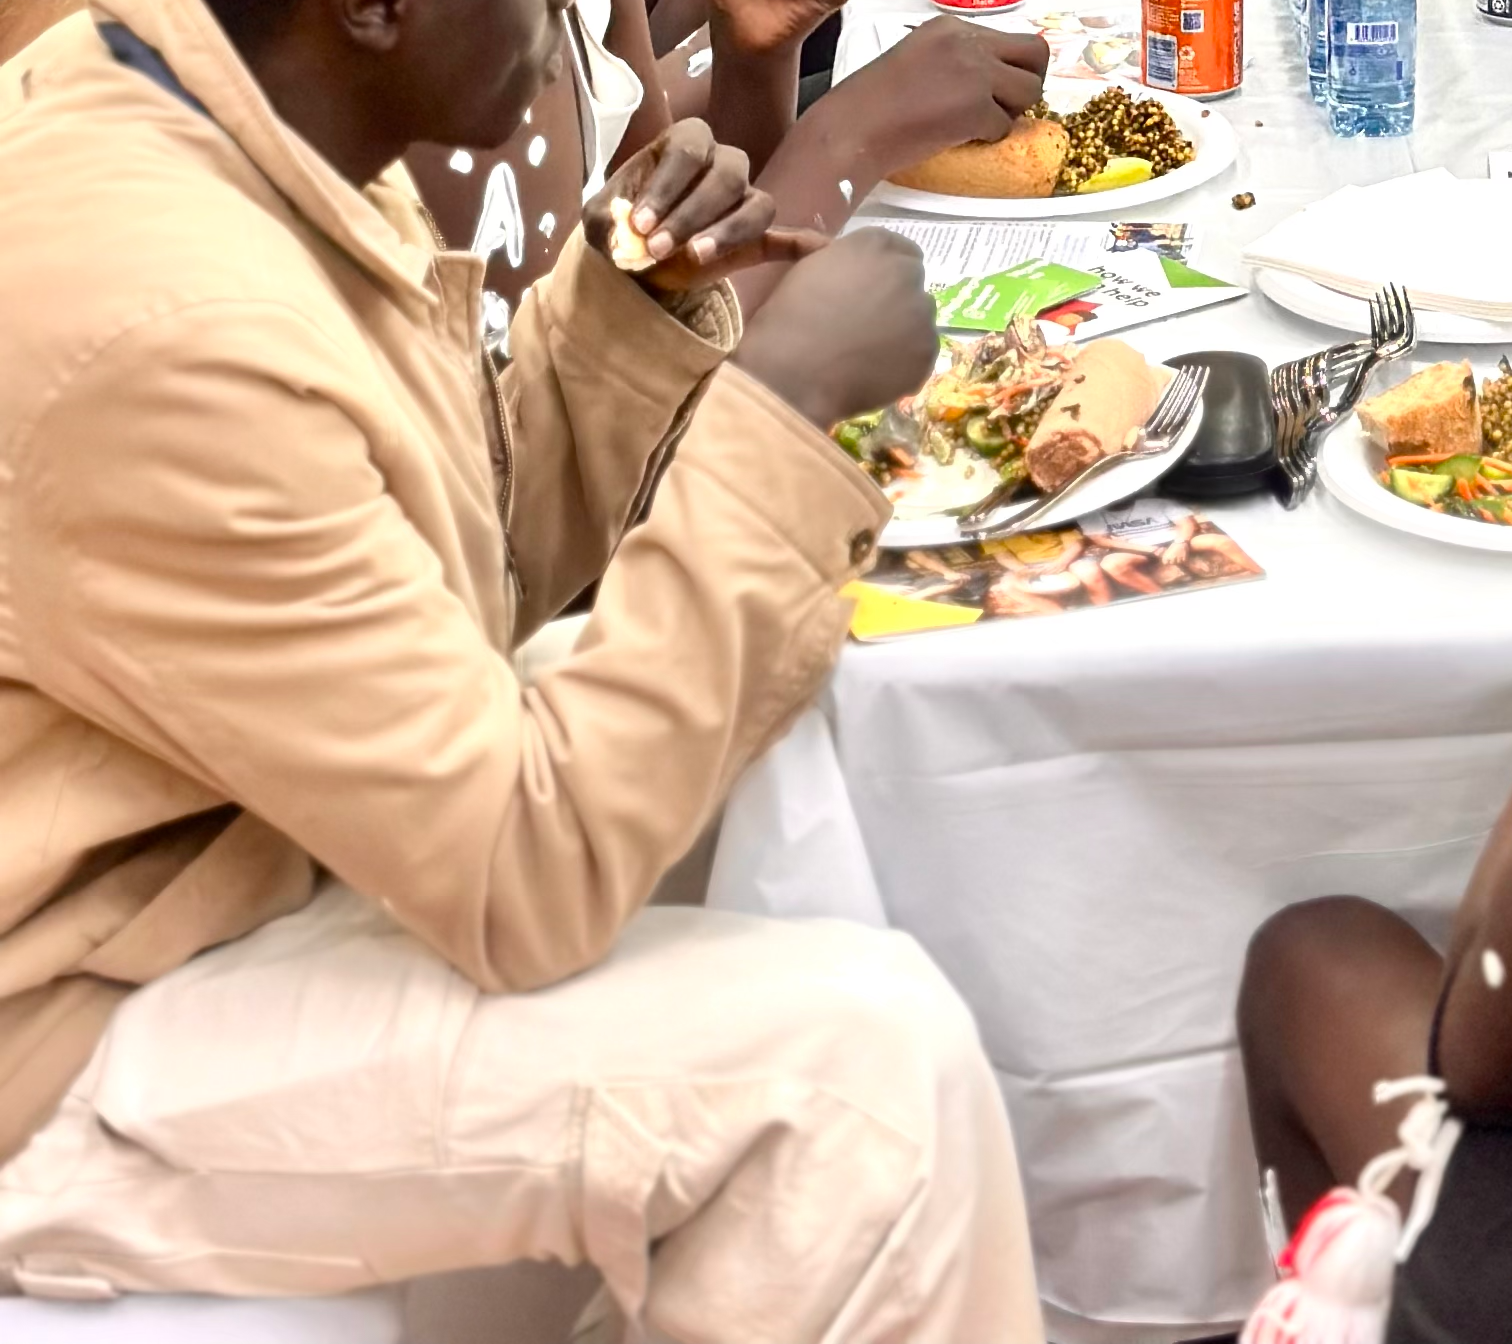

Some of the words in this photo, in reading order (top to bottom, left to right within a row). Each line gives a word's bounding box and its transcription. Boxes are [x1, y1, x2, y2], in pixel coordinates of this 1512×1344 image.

[1087, 265, 1134, 285] how
[1132, 283, 1161, 298] we
[1102, 287, 1149, 307] help
